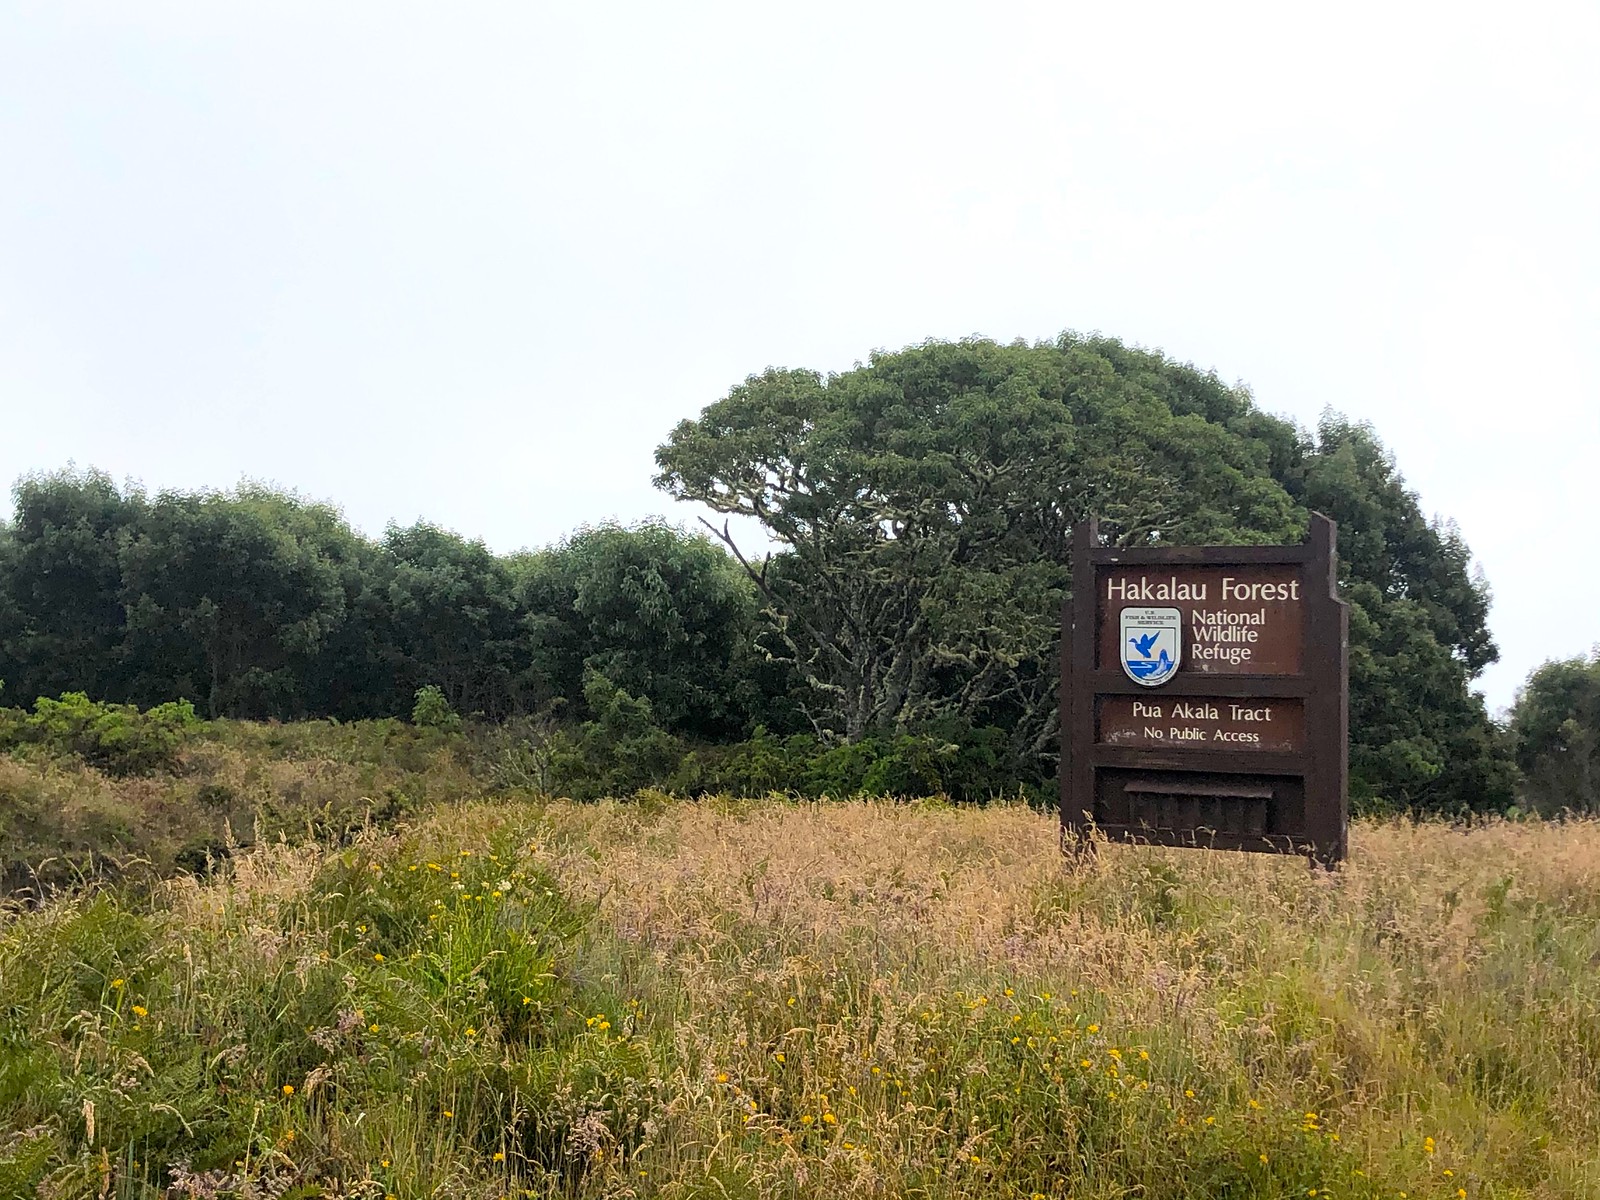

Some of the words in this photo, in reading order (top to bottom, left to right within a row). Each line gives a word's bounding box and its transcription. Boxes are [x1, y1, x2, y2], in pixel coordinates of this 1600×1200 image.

[1107, 576, 1207, 601] Hakalau
[1222, 577, 1299, 601] Forest
[1192, 608, 1266, 625] National
[1193, 625, 1259, 643] Wildlife
[1192, 643, 1252, 665] Refuge
[1132, 701, 1162, 718] Pua
[1171, 702, 1219, 720] Akala
[1228, 704, 1272, 722] Tract
[1143, 726, 1164, 740] No
[1170, 727, 1207, 741] Public
[1213, 729, 1260, 743] Access
